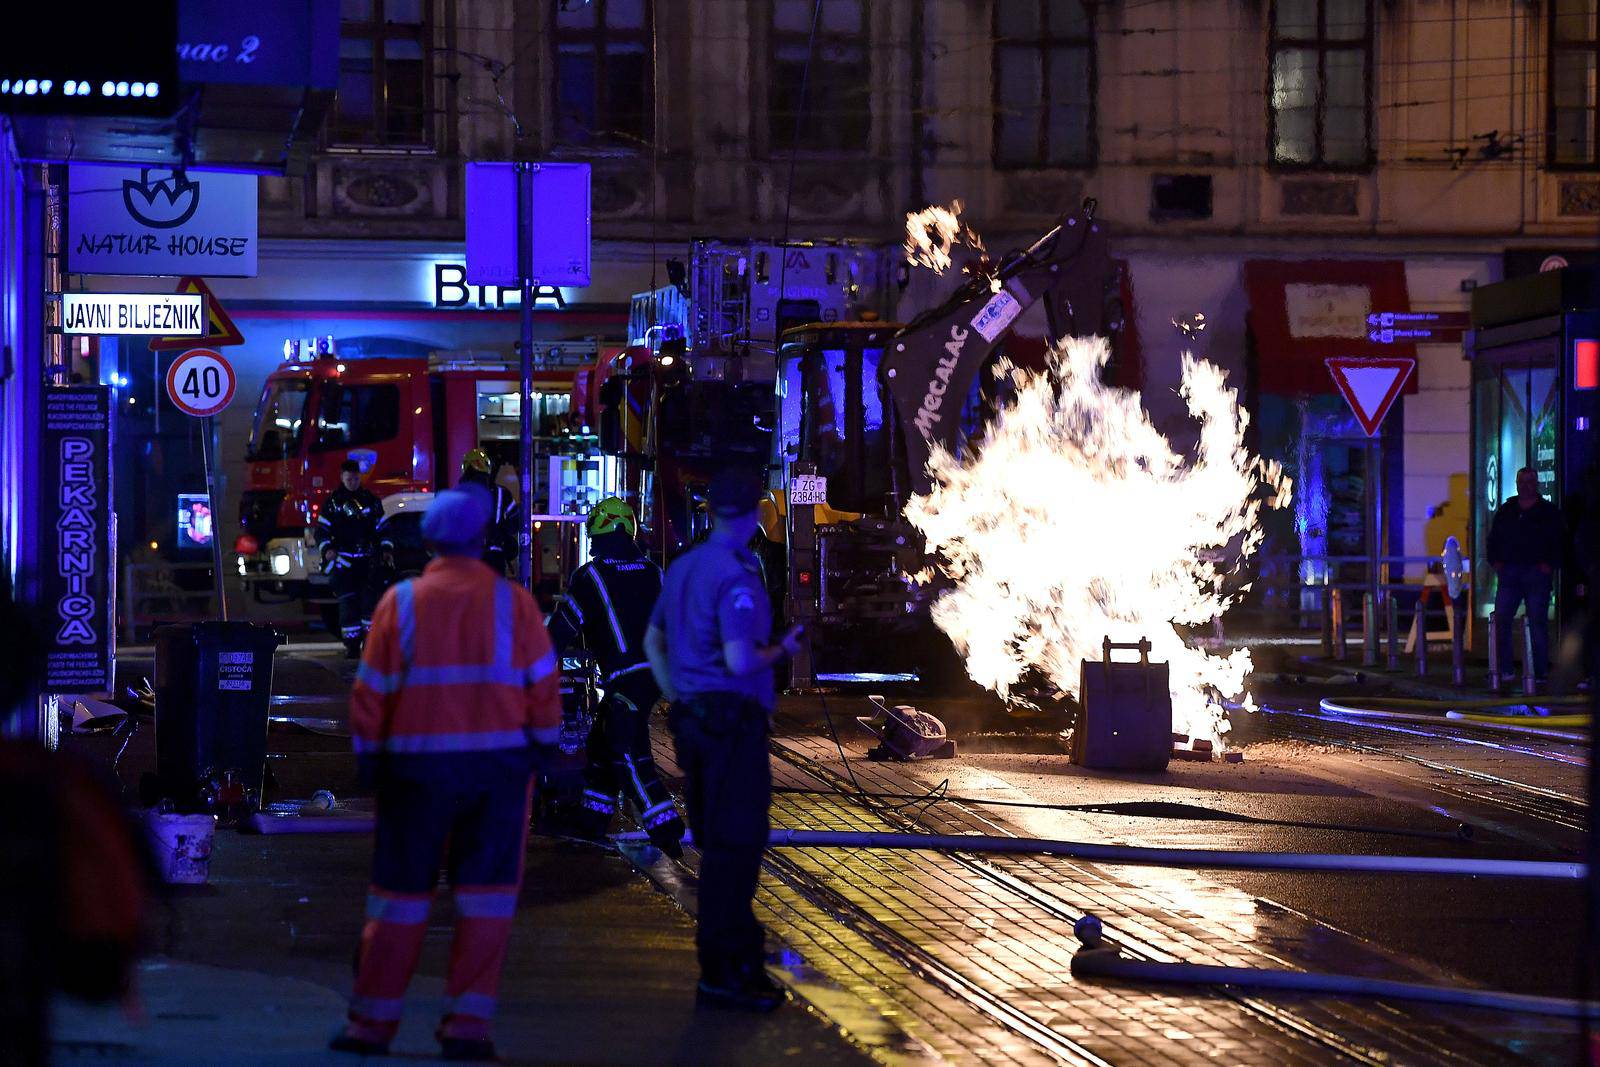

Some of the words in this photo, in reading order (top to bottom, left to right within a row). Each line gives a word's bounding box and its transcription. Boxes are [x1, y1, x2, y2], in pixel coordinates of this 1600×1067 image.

[235, 34, 260, 64] 2
[77, 233, 161, 255] NATUR
[168, 234, 249, 257] HOUSE
[65, 304, 111, 329] JAVNI
[118, 297, 200, 330] BILJEŽNIK
[182, 366, 221, 399] 40
[802, 480, 815, 491] ZG
[59, 440, 93, 641] PEKARNICA
